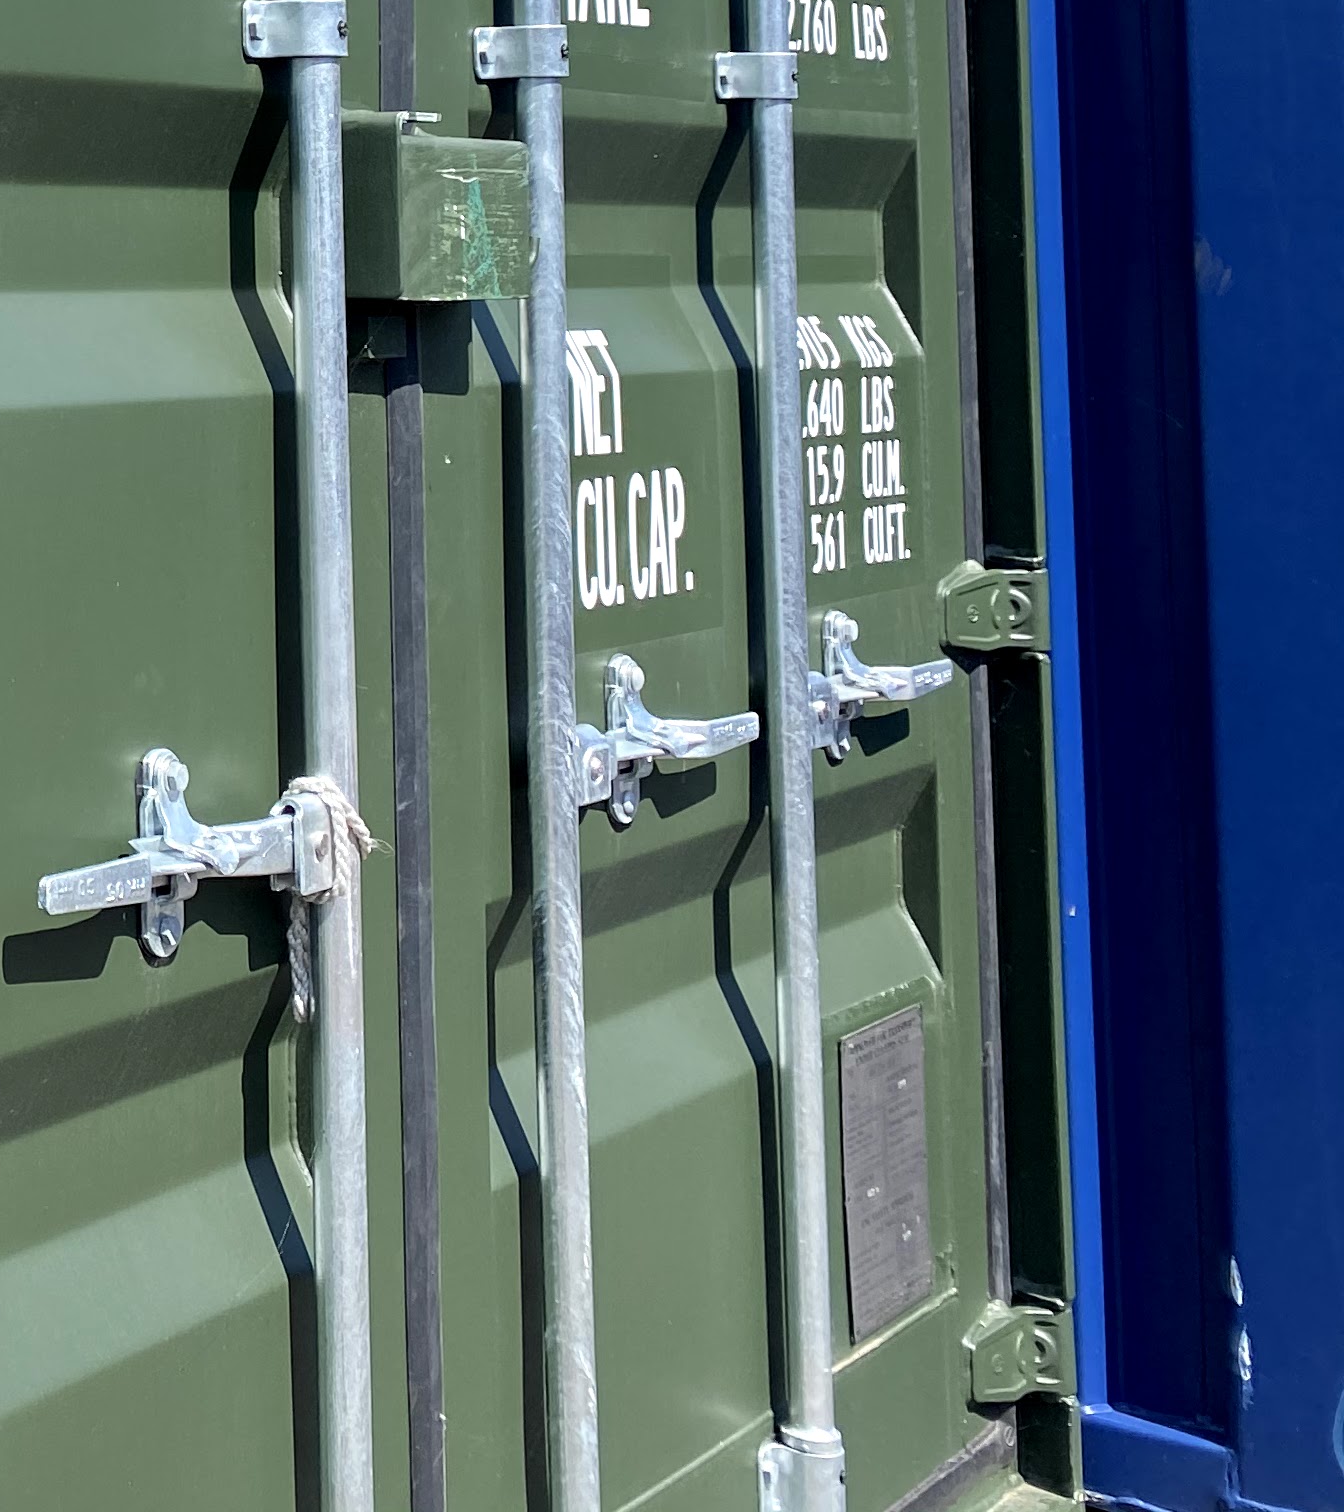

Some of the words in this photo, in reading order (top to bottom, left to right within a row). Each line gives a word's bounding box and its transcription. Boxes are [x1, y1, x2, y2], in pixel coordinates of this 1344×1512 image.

[852, 2, 888, 62] LBS
[565, 328, 624, 457] NET
[838, 315, 894, 369] KGS
[861, 375, 895, 434] LBS
[806, 444, 845, 506] 15.9
[862, 439, 906, 499] CU.M.
[810, 510, 846, 574] 561
[863, 502, 911, 565] CU.FT.
